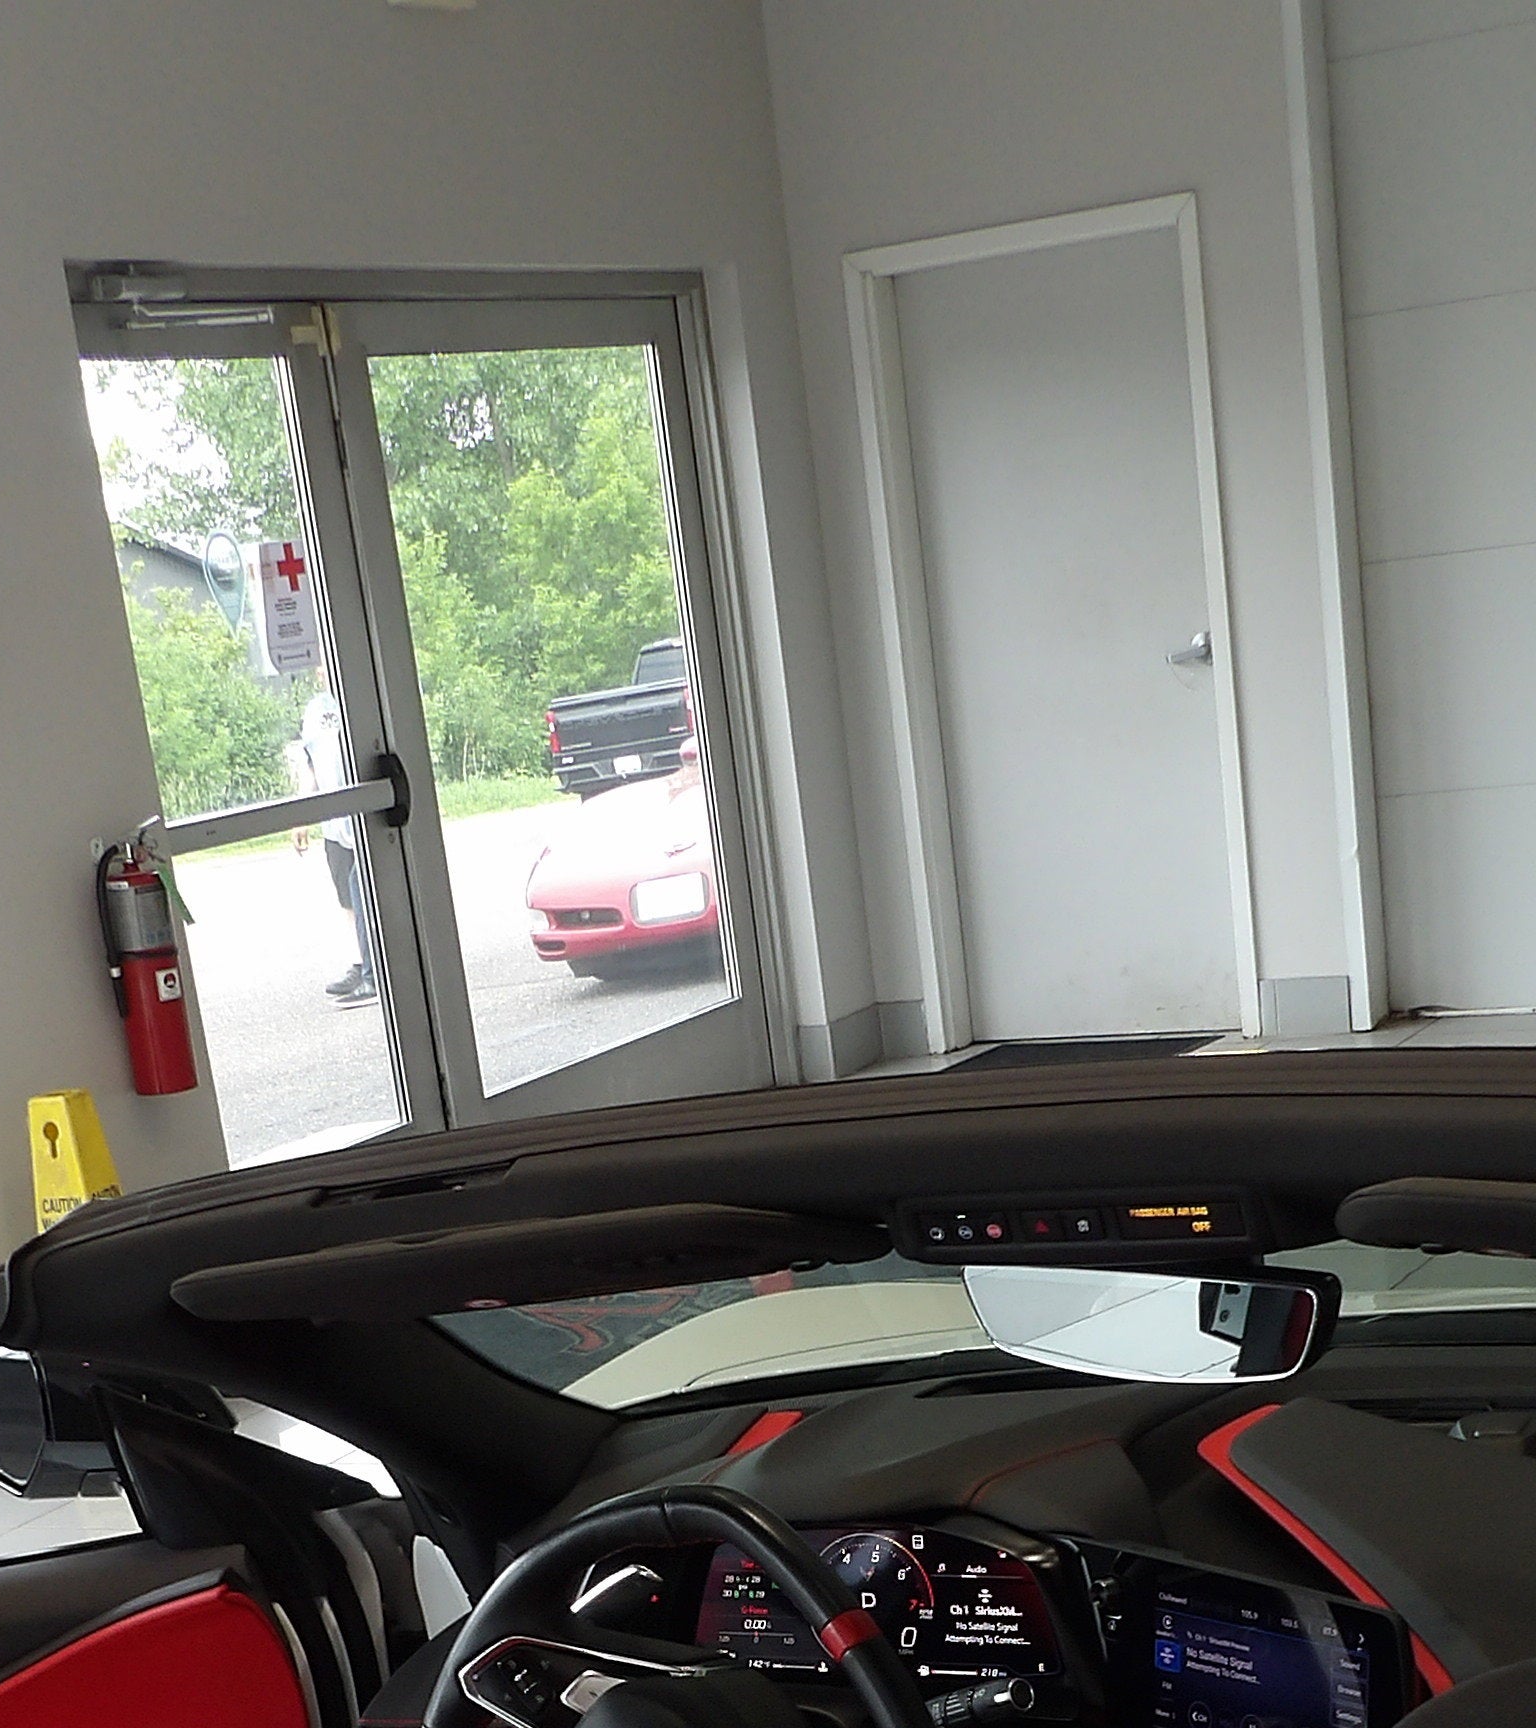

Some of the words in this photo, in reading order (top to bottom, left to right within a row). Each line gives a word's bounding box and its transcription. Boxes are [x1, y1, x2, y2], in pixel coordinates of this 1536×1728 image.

[1191, 1220, 1212, 1232] OFF
[842, 1553, 851, 1565] 4
[871, 1552, 880, 1563] 5
[897, 1569, 906, 1580] 6
[966, 1564, 987, 1574] Audio
[861, 1592, 876, 1608] D
[949, 1605, 963, 1615] Ch
[955, 1621, 967, 1630] No
[968, 1621, 996, 1631] Satellite
[996, 1622, 1019, 1634] Signal
[901, 1626, 917, 1647] 0
[945, 1634, 984, 1646] Attempting
[984, 1635, 993, 1644] To
[1186, 1646, 1198, 1658] No
[1198, 1650, 1229, 1665] Satellite
[1229, 1656, 1254, 1671] Signal
[1186, 1660, 1221, 1677] Attempting
[1221, 1668, 1231, 1678] To
